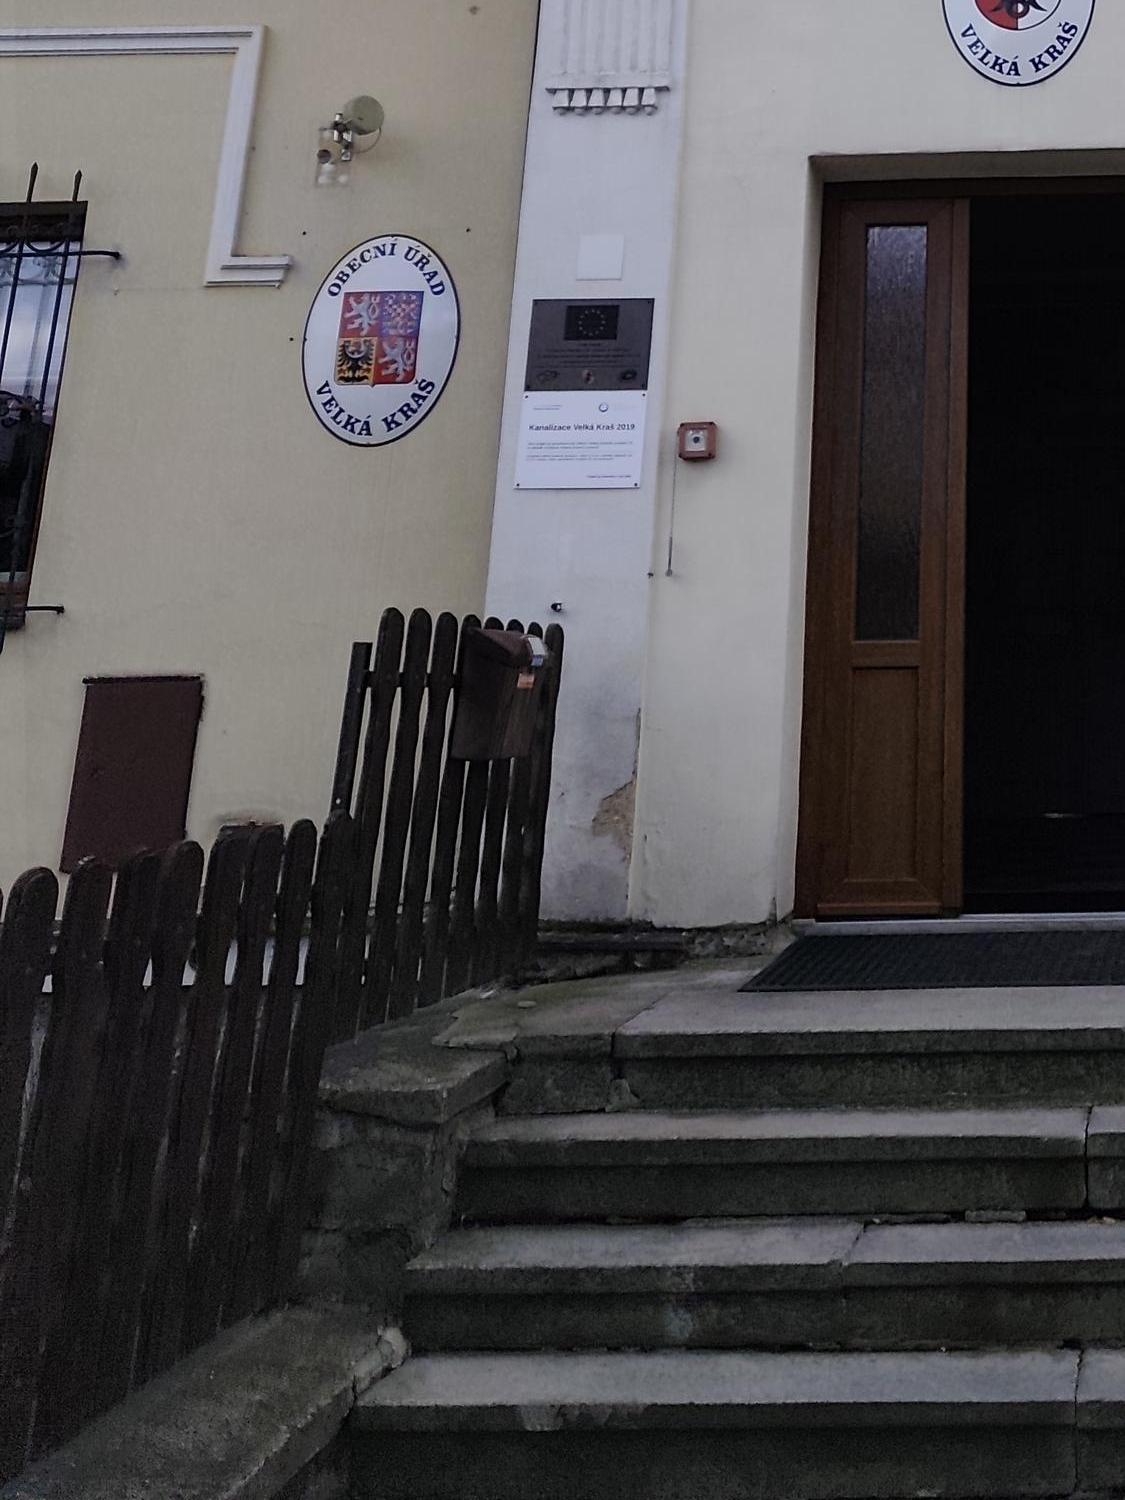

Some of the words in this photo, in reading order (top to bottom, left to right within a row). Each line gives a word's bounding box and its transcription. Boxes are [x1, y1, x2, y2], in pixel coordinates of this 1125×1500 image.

[961, 23, 1021, 76] VELKÁ
[1029, 21, 1078, 73] KRAŠ
[327, 238, 398, 297] OBECNÍ
[404, 245, 446, 297] ÚŘAD
[315, 380, 373, 436] VELKÁ
[381, 378, 436, 433] KRAŠ
[573, 423, 594, 431] Velká
[596, 423, 615, 431] Kraš
[616, 423, 635, 431] 2019
